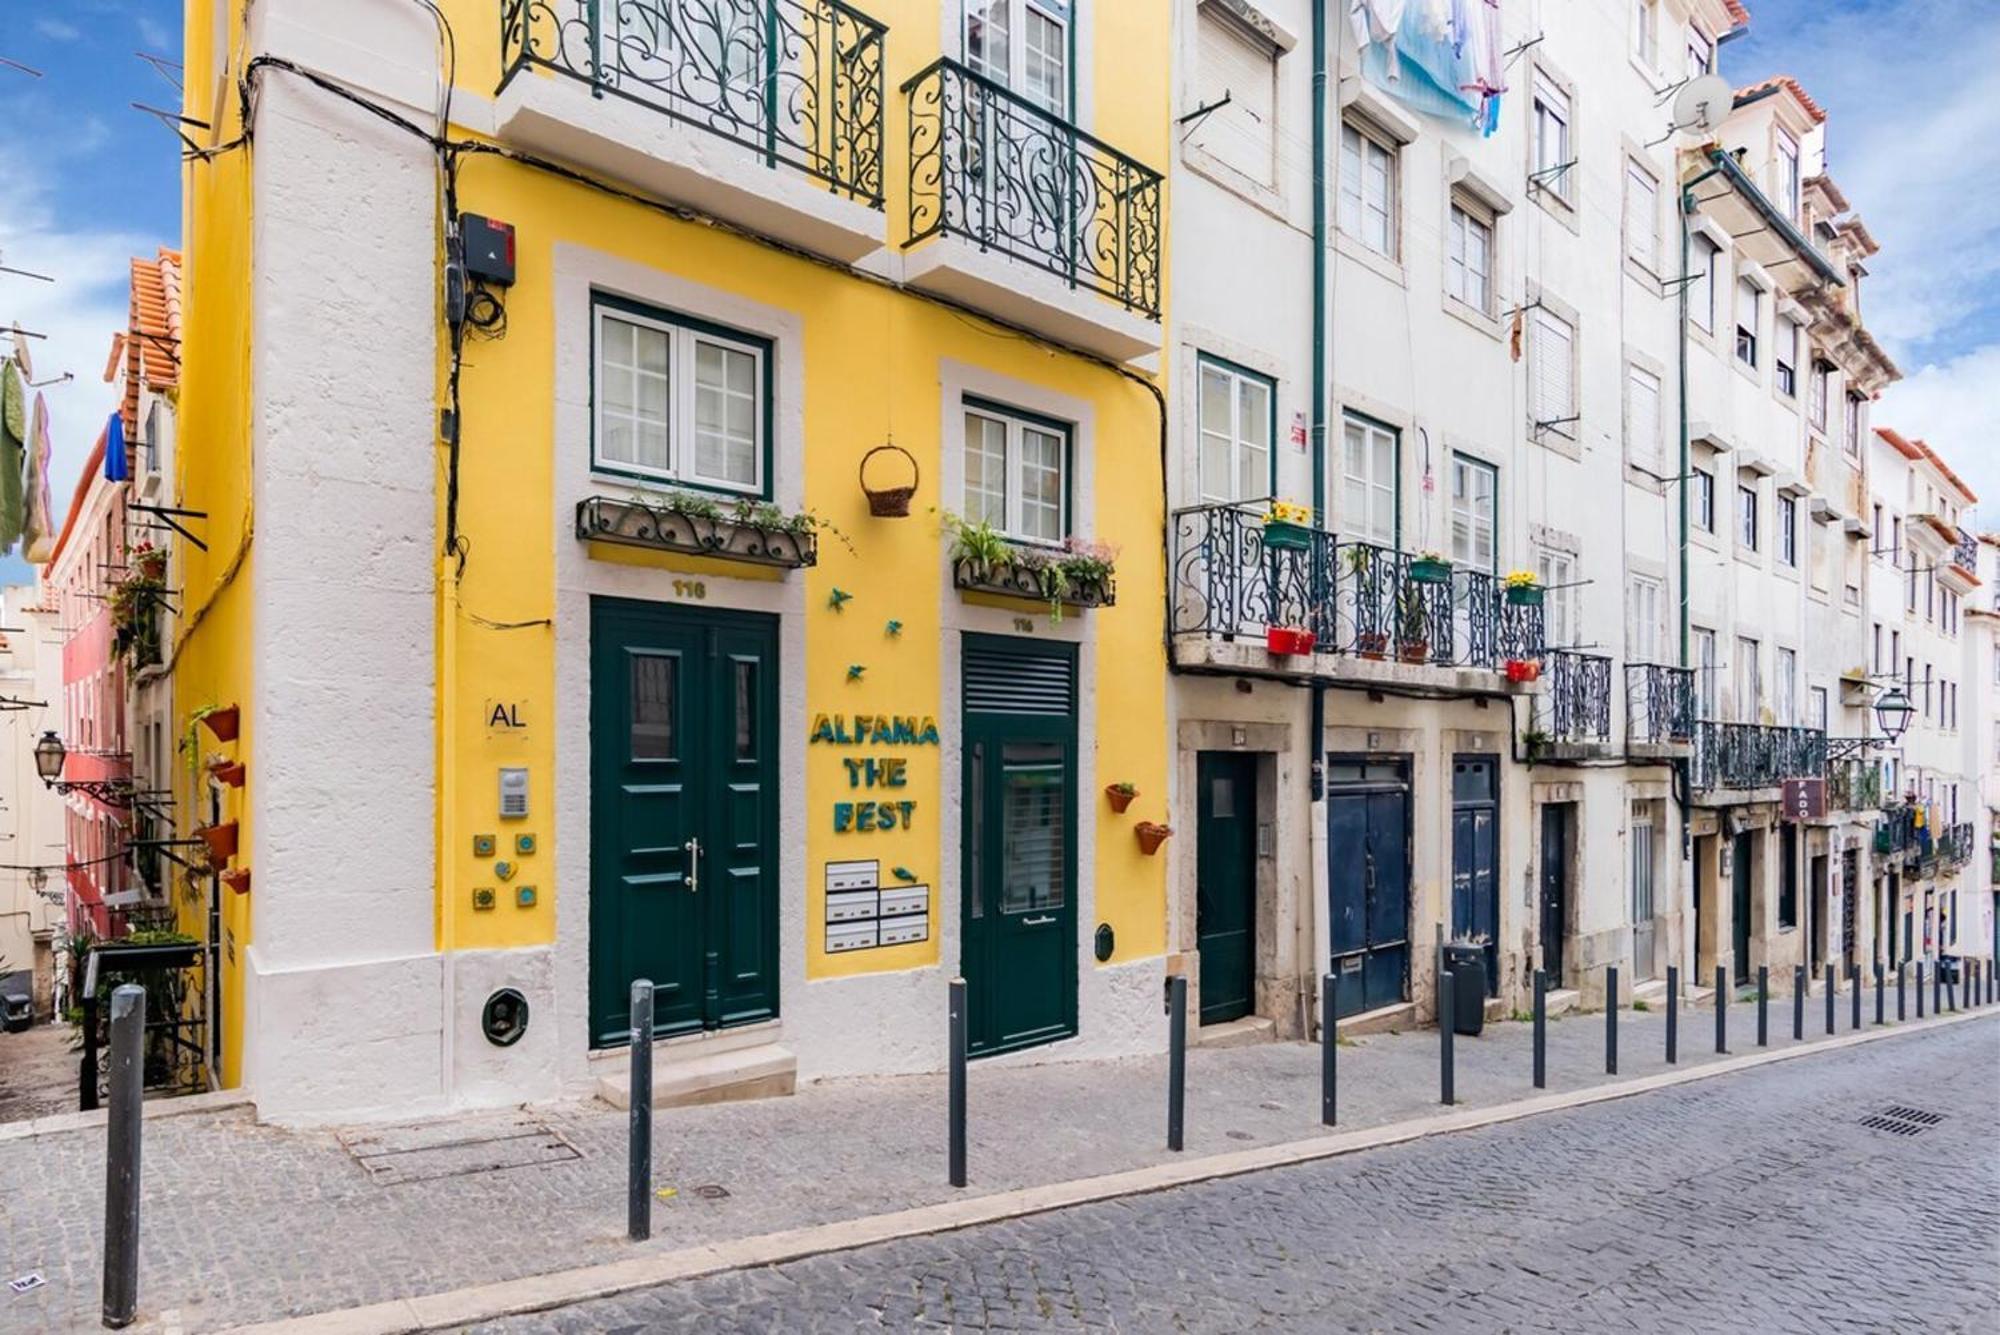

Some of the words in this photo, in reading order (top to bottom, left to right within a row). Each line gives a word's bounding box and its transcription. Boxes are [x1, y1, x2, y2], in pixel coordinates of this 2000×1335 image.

[490, 703, 526, 727] AL
[809, 713, 940, 745] ALFAMA
[842, 757, 907, 788] THE
[1798, 781, 1809, 818] FADO
[834, 801, 917, 833] BEST
